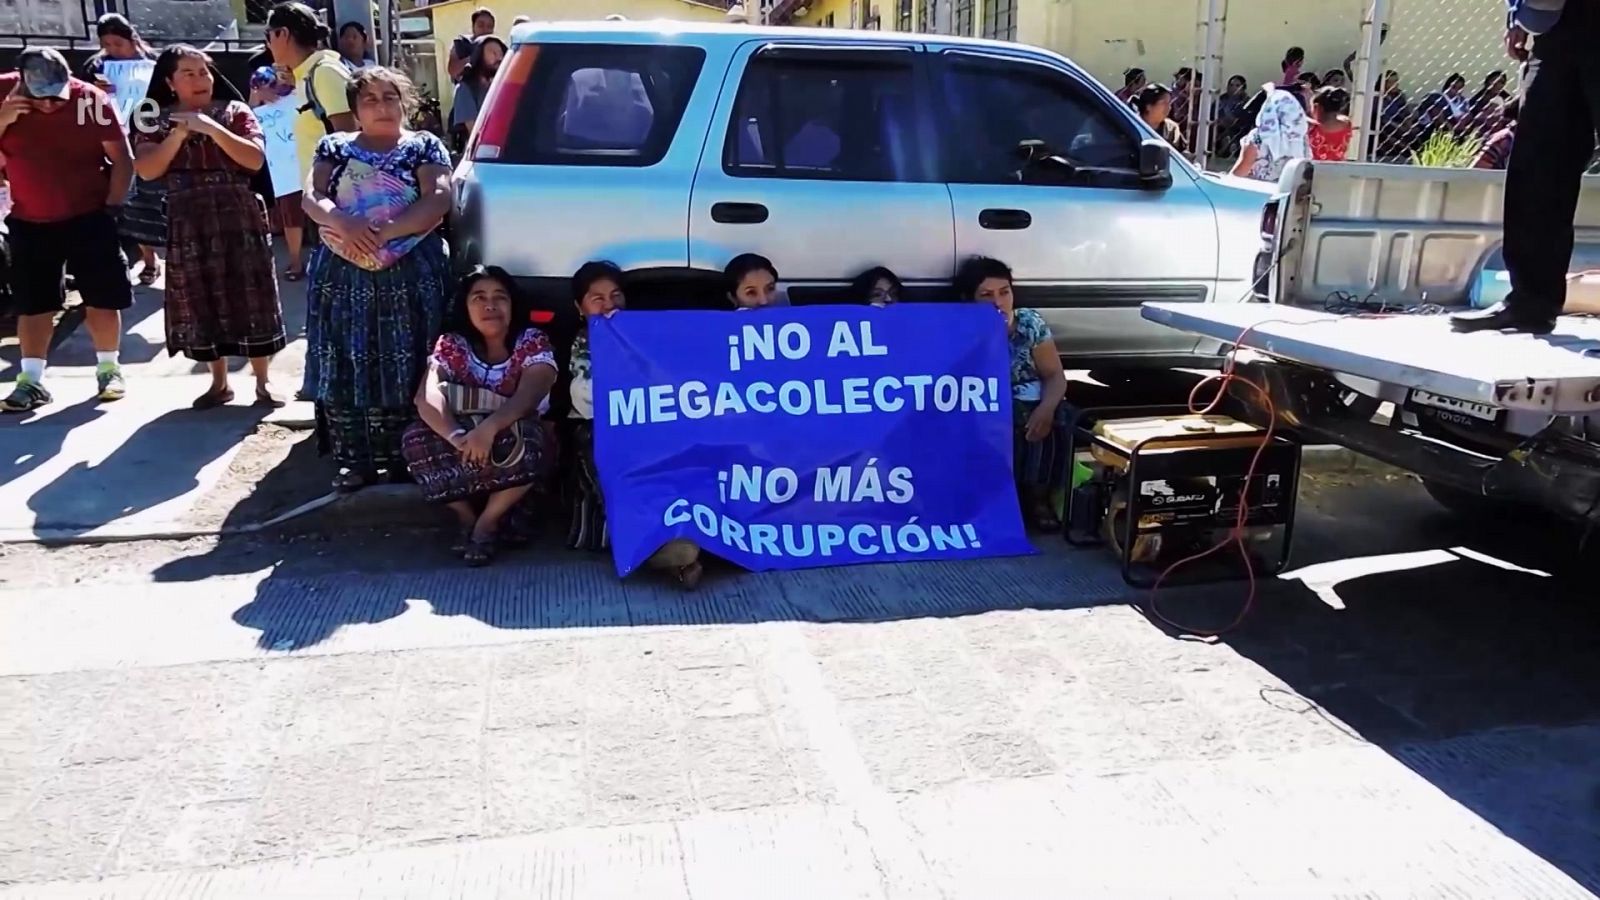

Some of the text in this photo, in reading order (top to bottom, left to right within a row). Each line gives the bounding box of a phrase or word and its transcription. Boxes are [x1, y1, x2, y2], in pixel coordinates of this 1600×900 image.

[729, 321, 887, 371] ¡NO AL
[609, 375, 998, 425] MEGACOLECTOR!
[1435, 410, 1473, 426] TOYOTA
[719, 458, 914, 503] ¡NO MÁS
[1166, 494, 1205, 504] SUBARU
[664, 498, 980, 557] CORRUPCIÓN!
